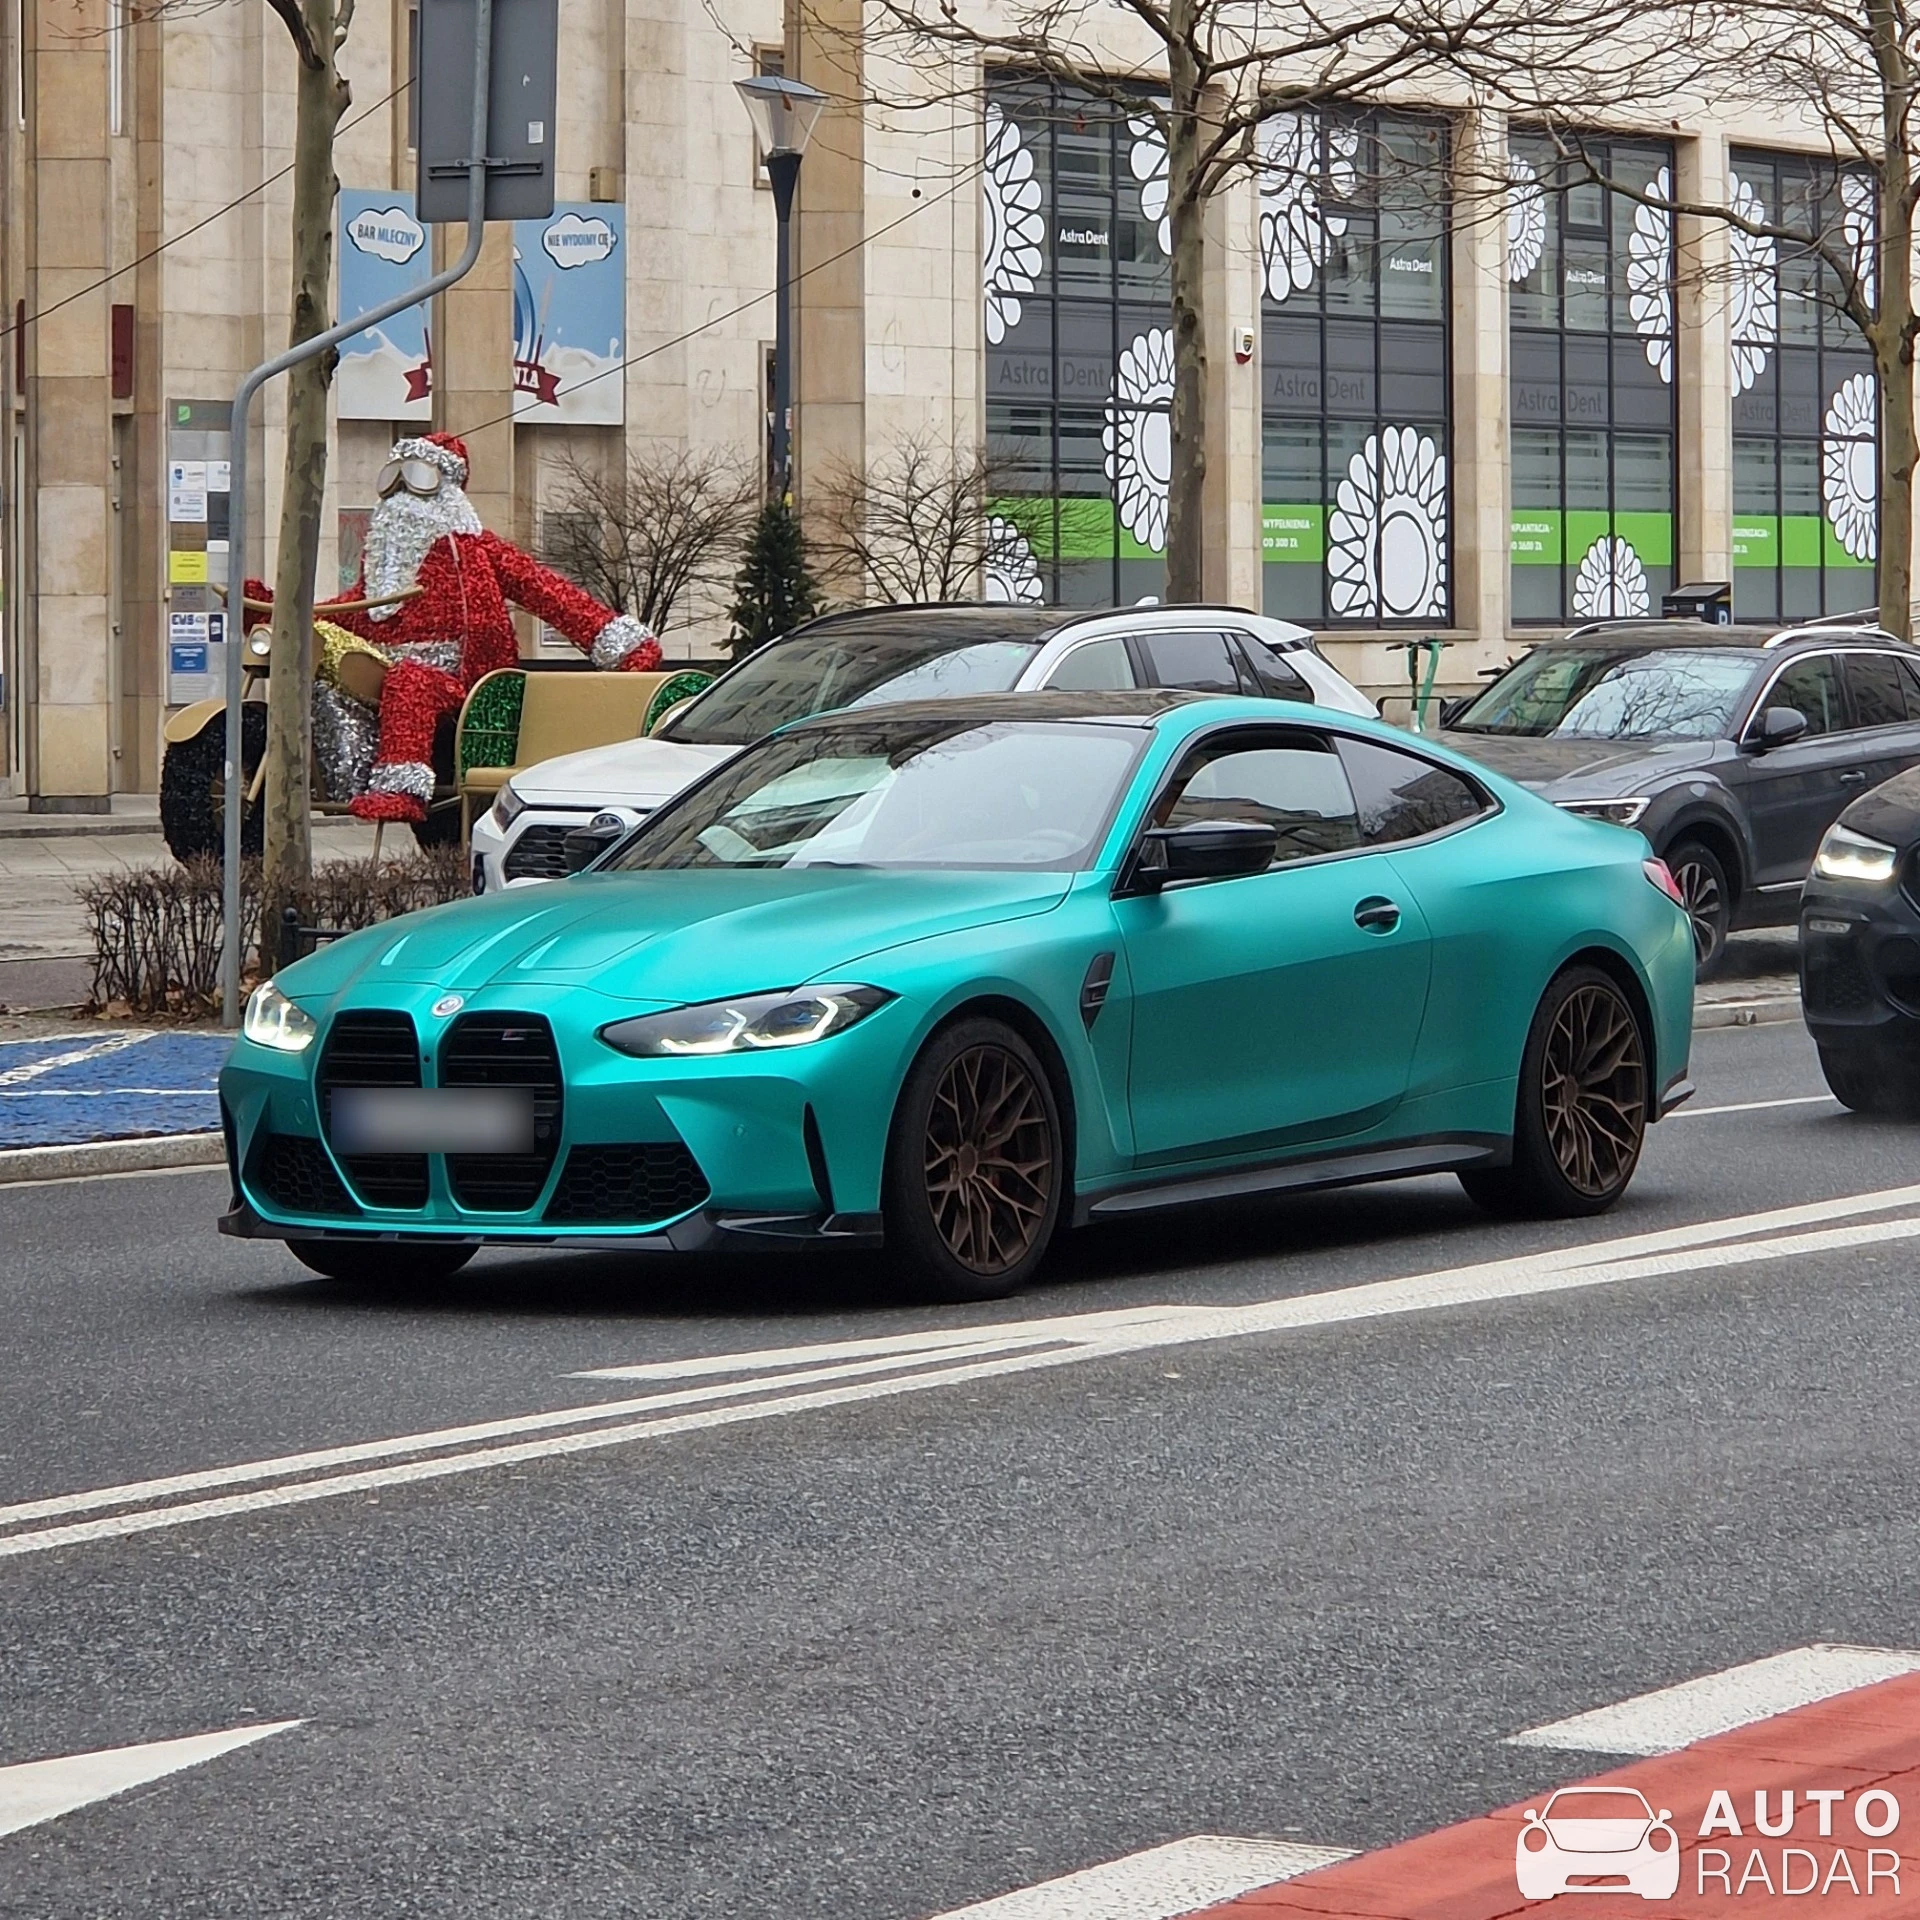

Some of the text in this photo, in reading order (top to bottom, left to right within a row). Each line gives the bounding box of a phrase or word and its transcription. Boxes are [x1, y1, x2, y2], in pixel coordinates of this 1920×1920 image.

[358, 223, 418, 247] BAR MLECZNY
[548, 234, 561, 247] NIE
[1060, 228, 1109, 246] Astra Dent
[1000, 359, 1105, 387] Astra Dent
[1273, 372, 1366, 401] Astra Dent
[1516, 386, 1605, 414] Astra Dent
